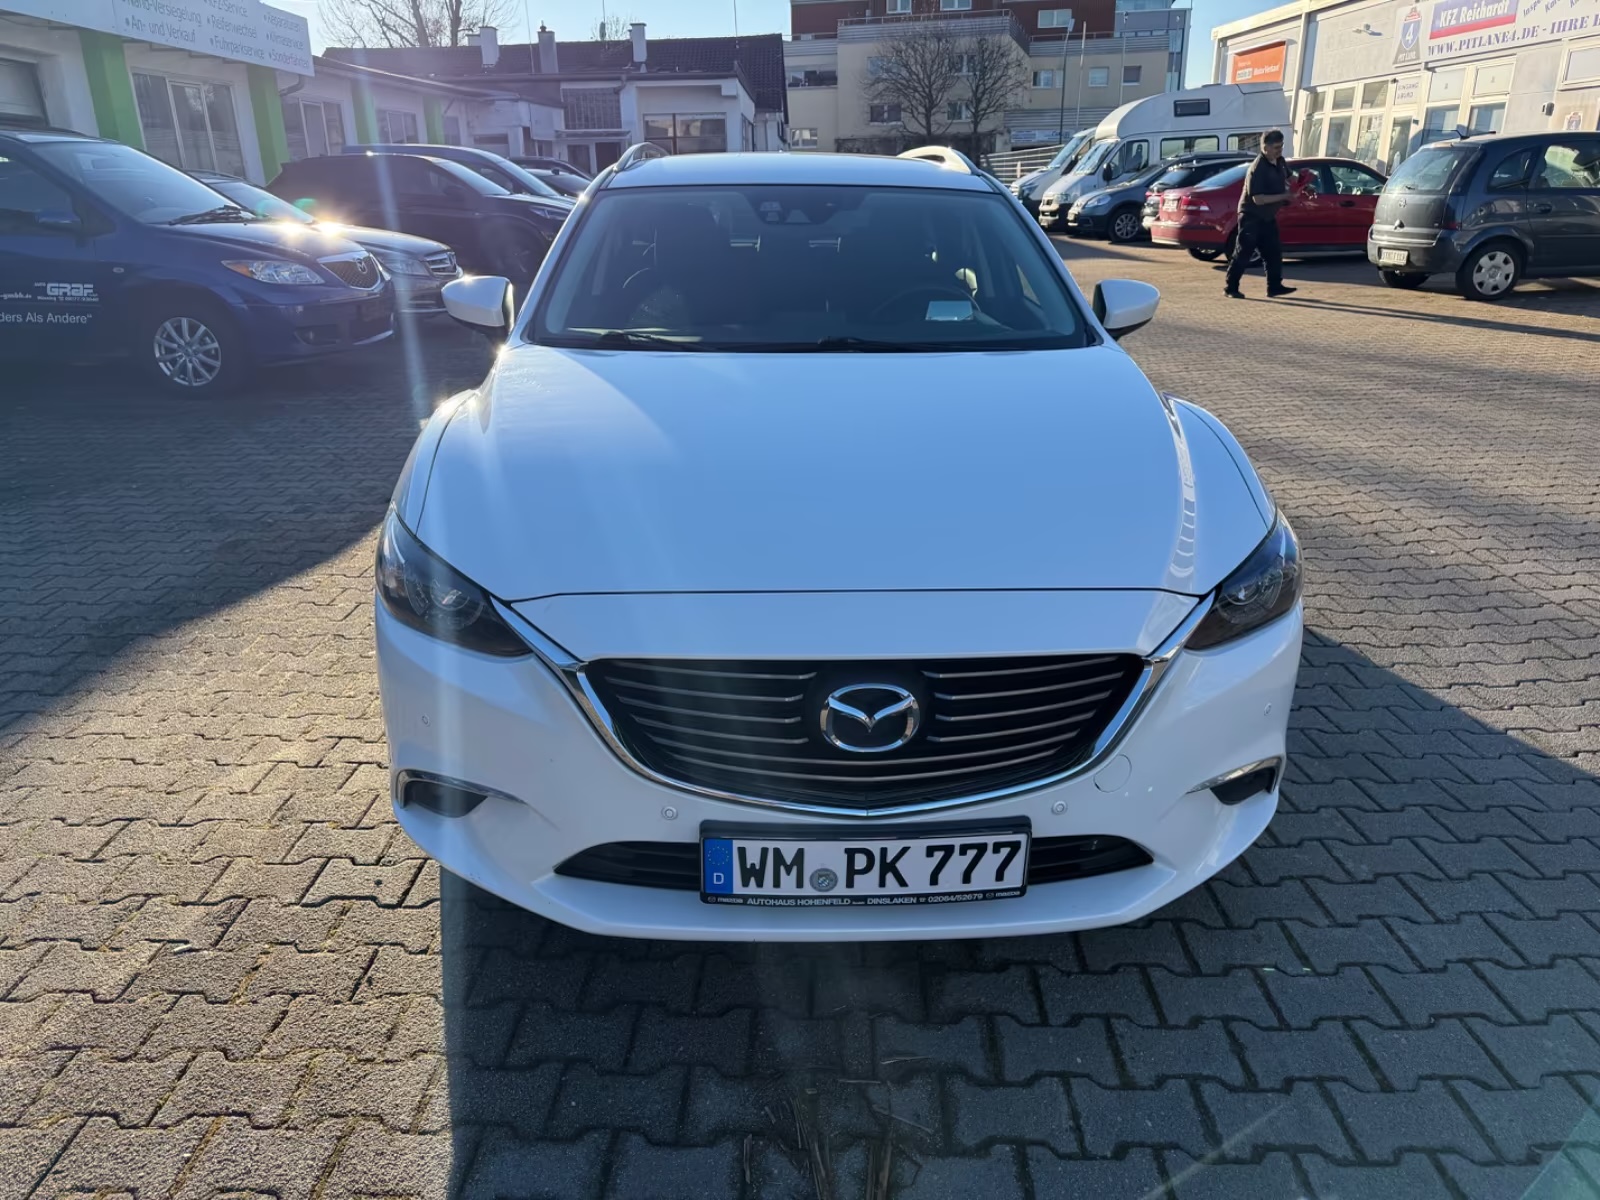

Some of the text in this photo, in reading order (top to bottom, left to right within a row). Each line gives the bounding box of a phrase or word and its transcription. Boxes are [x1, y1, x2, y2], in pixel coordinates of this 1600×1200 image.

[1440, 0, 1510, 28] KFZ Reichardt
[148, 21, 165, 36] und
[166, 22, 196, 43] Verkauf
[1405, 22, 1414, 43] 4
[1550, 16, 1590, 34] IHRE
[26, 312, 43, 323] Als
[737, 840, 1022, 889] WM PK 777
[713, 873, 725, 885] D
[747, 898, 796, 907] AUTOHAUS
[797, 898, 851, 907] HOHENFELD
[867, 896, 917, 906] DINSLAKEN
